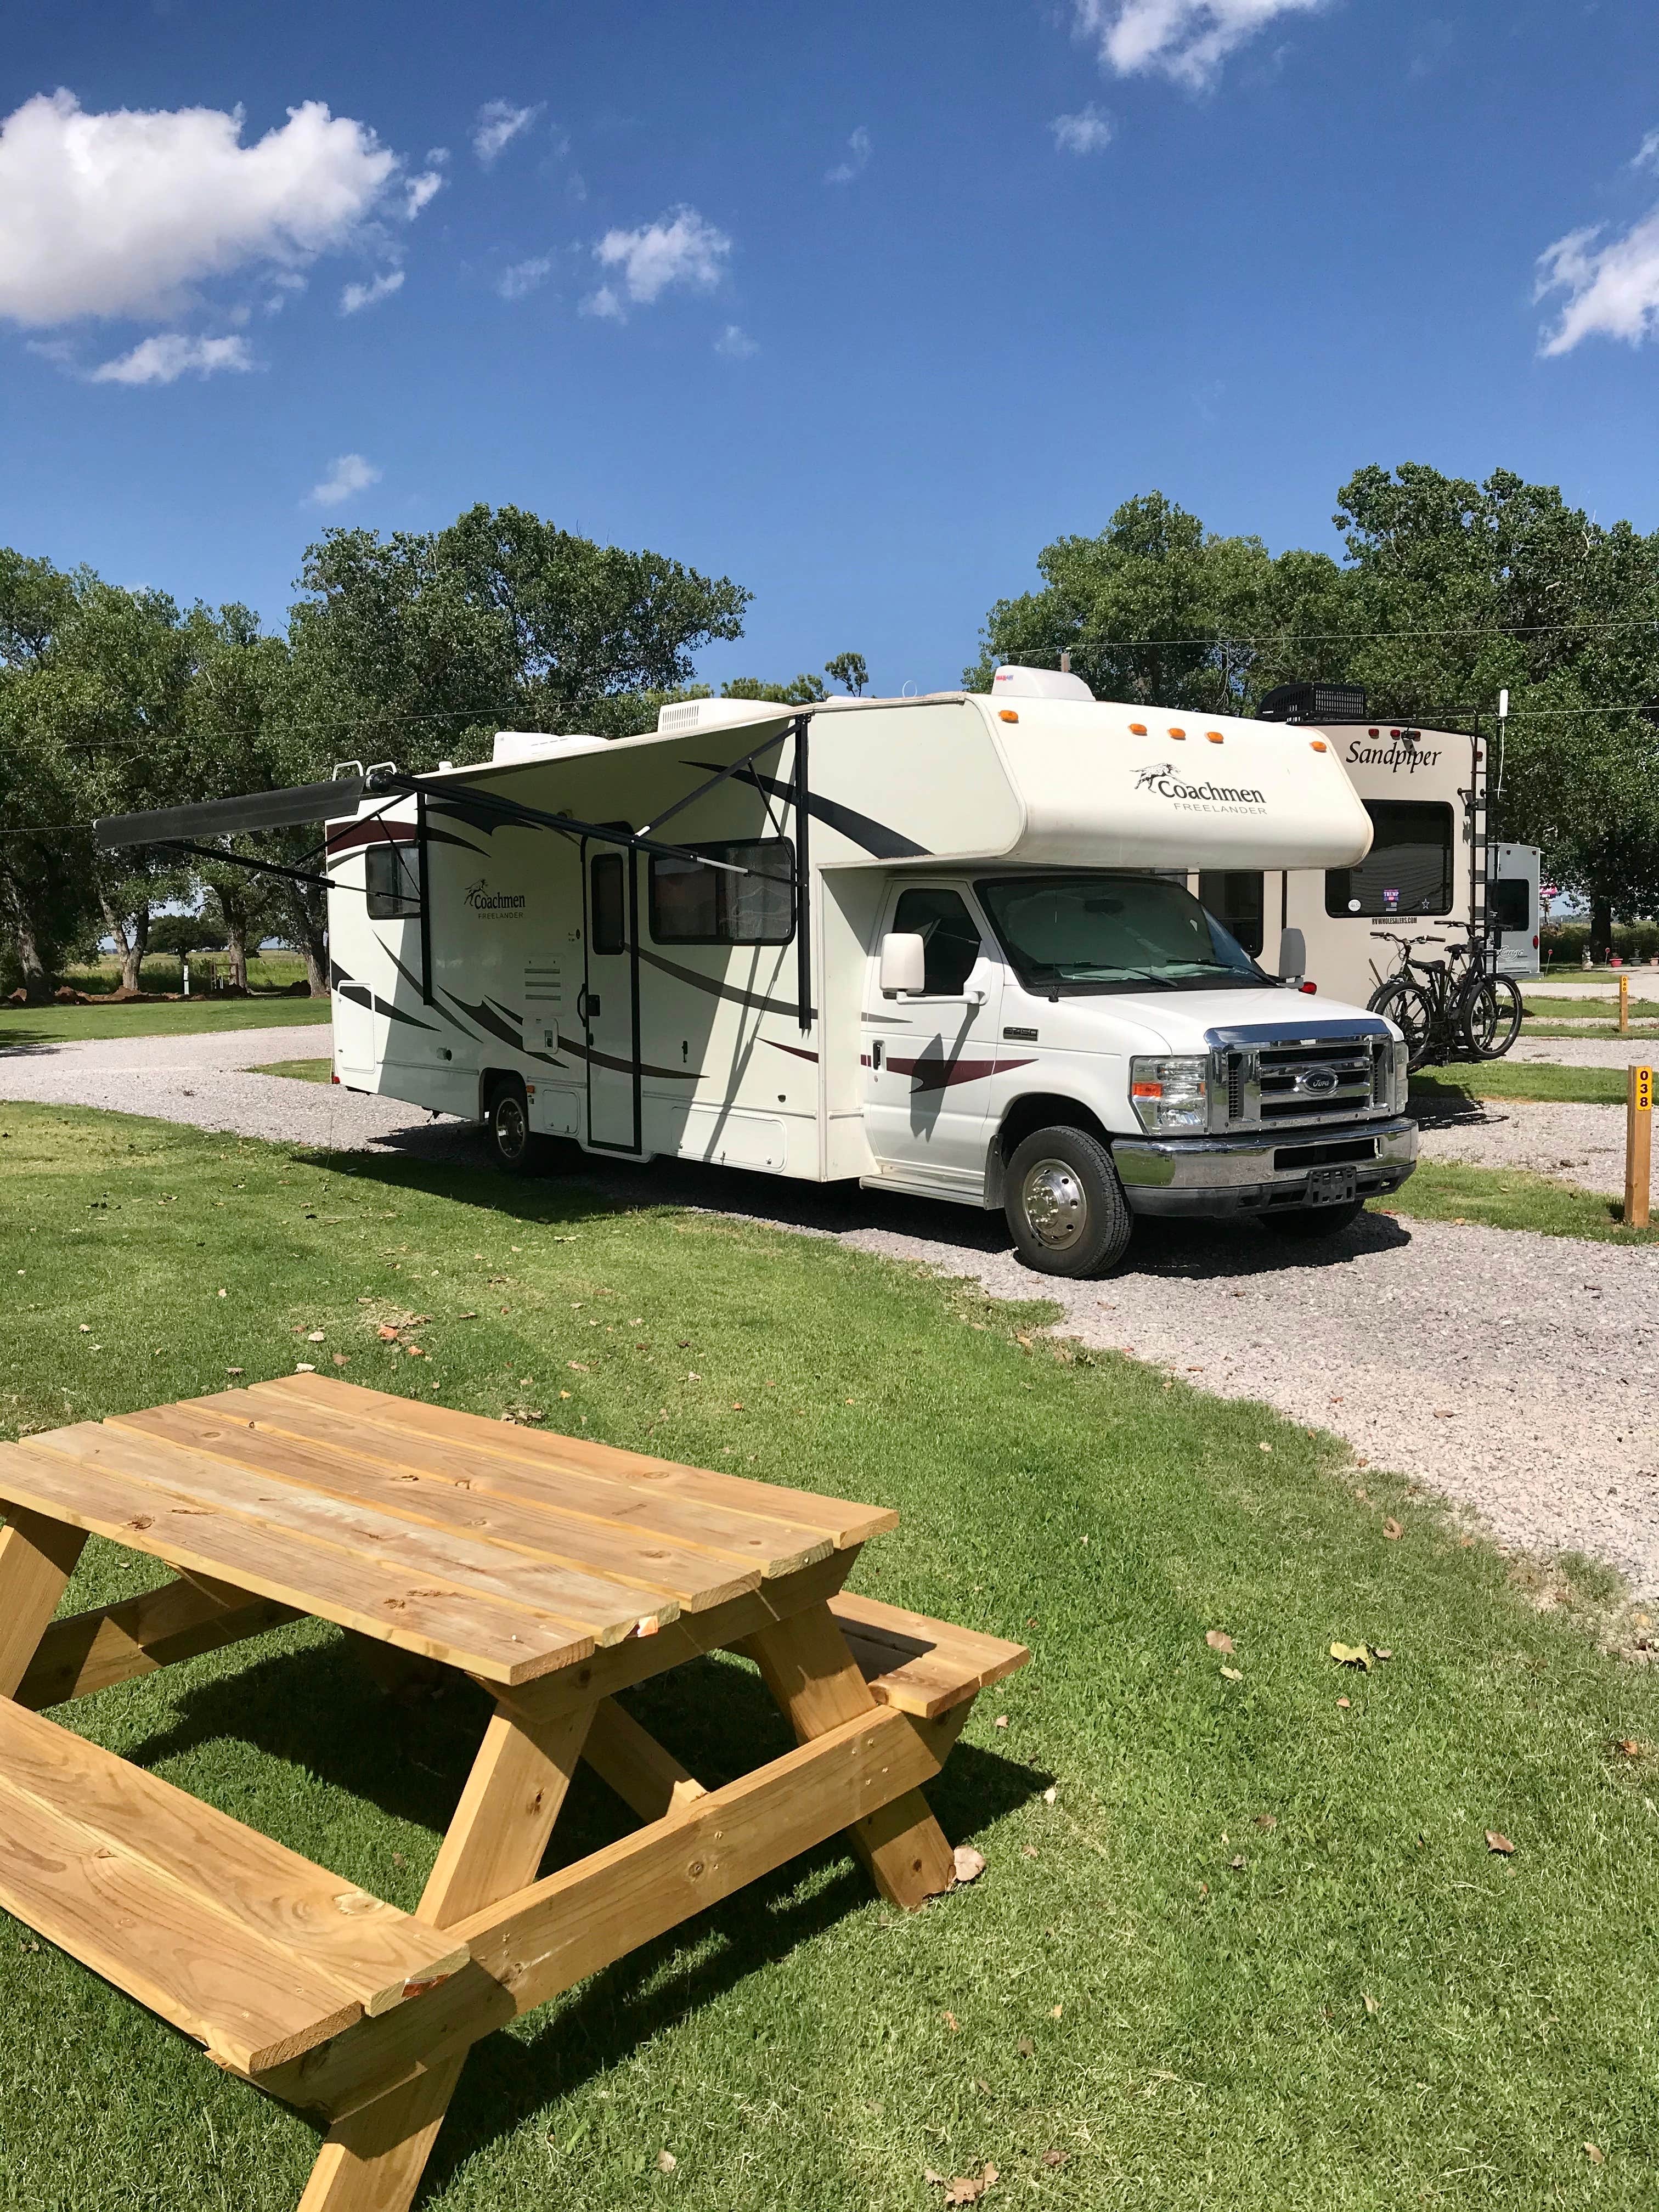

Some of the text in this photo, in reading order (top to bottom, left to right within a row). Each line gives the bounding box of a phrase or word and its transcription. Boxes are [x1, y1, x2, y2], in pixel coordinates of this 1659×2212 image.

[1346, 741, 1442, 774] Sandpiper
[1158, 780, 1267, 803] Coachmen
[1173, 803, 1268, 815] FREELANDER
[475, 891, 526, 910] Coachmen
[1372, 917, 1417, 925] RVWHOLESALERS.COM
[1313, 1079, 1330, 1087] Ford
[1640, 1070, 1649, 1107] 038
